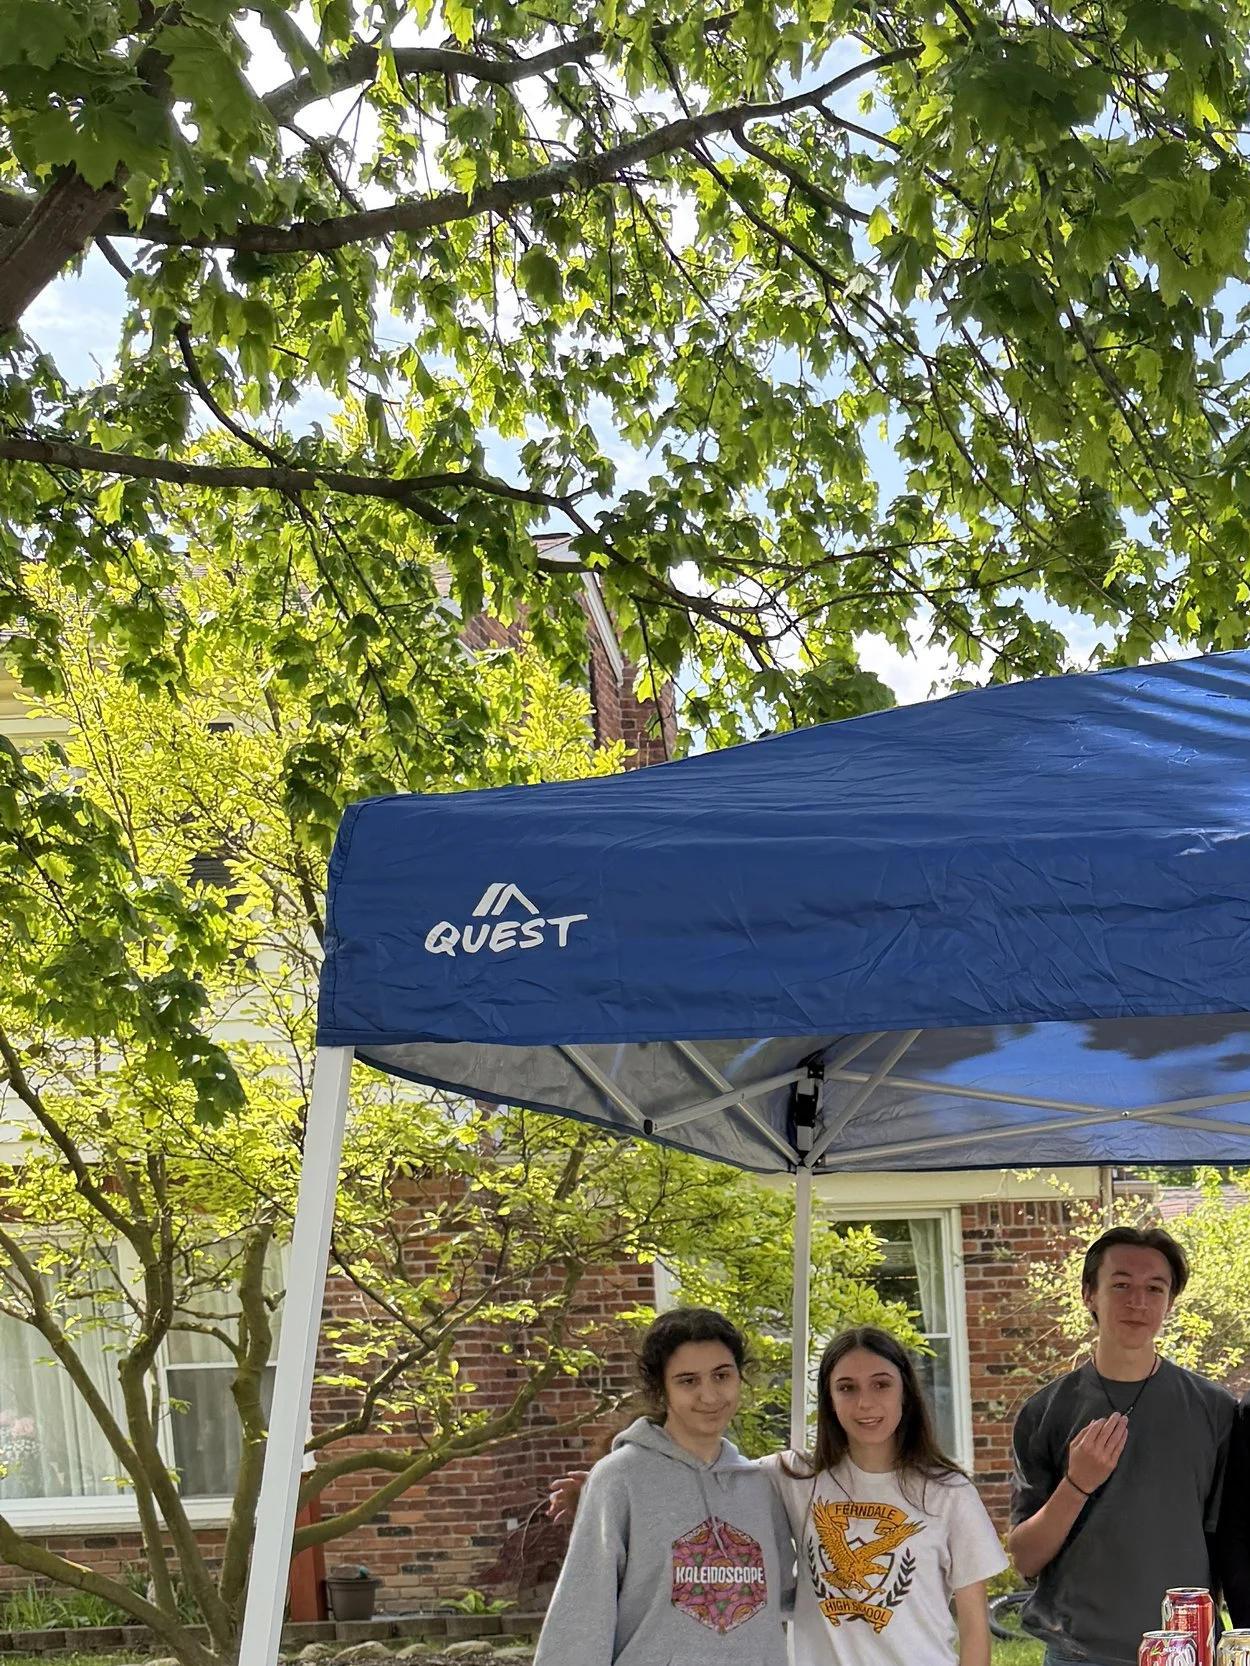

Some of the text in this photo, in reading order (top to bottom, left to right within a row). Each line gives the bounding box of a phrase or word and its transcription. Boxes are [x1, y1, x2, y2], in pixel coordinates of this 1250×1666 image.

[425, 914, 588, 957] QUEST
[835, 1504, 897, 1520] FERNDALE
[676, 1566, 765, 1583] KALEIDOSCOPE
[825, 1601, 851, 1613] HIGH
